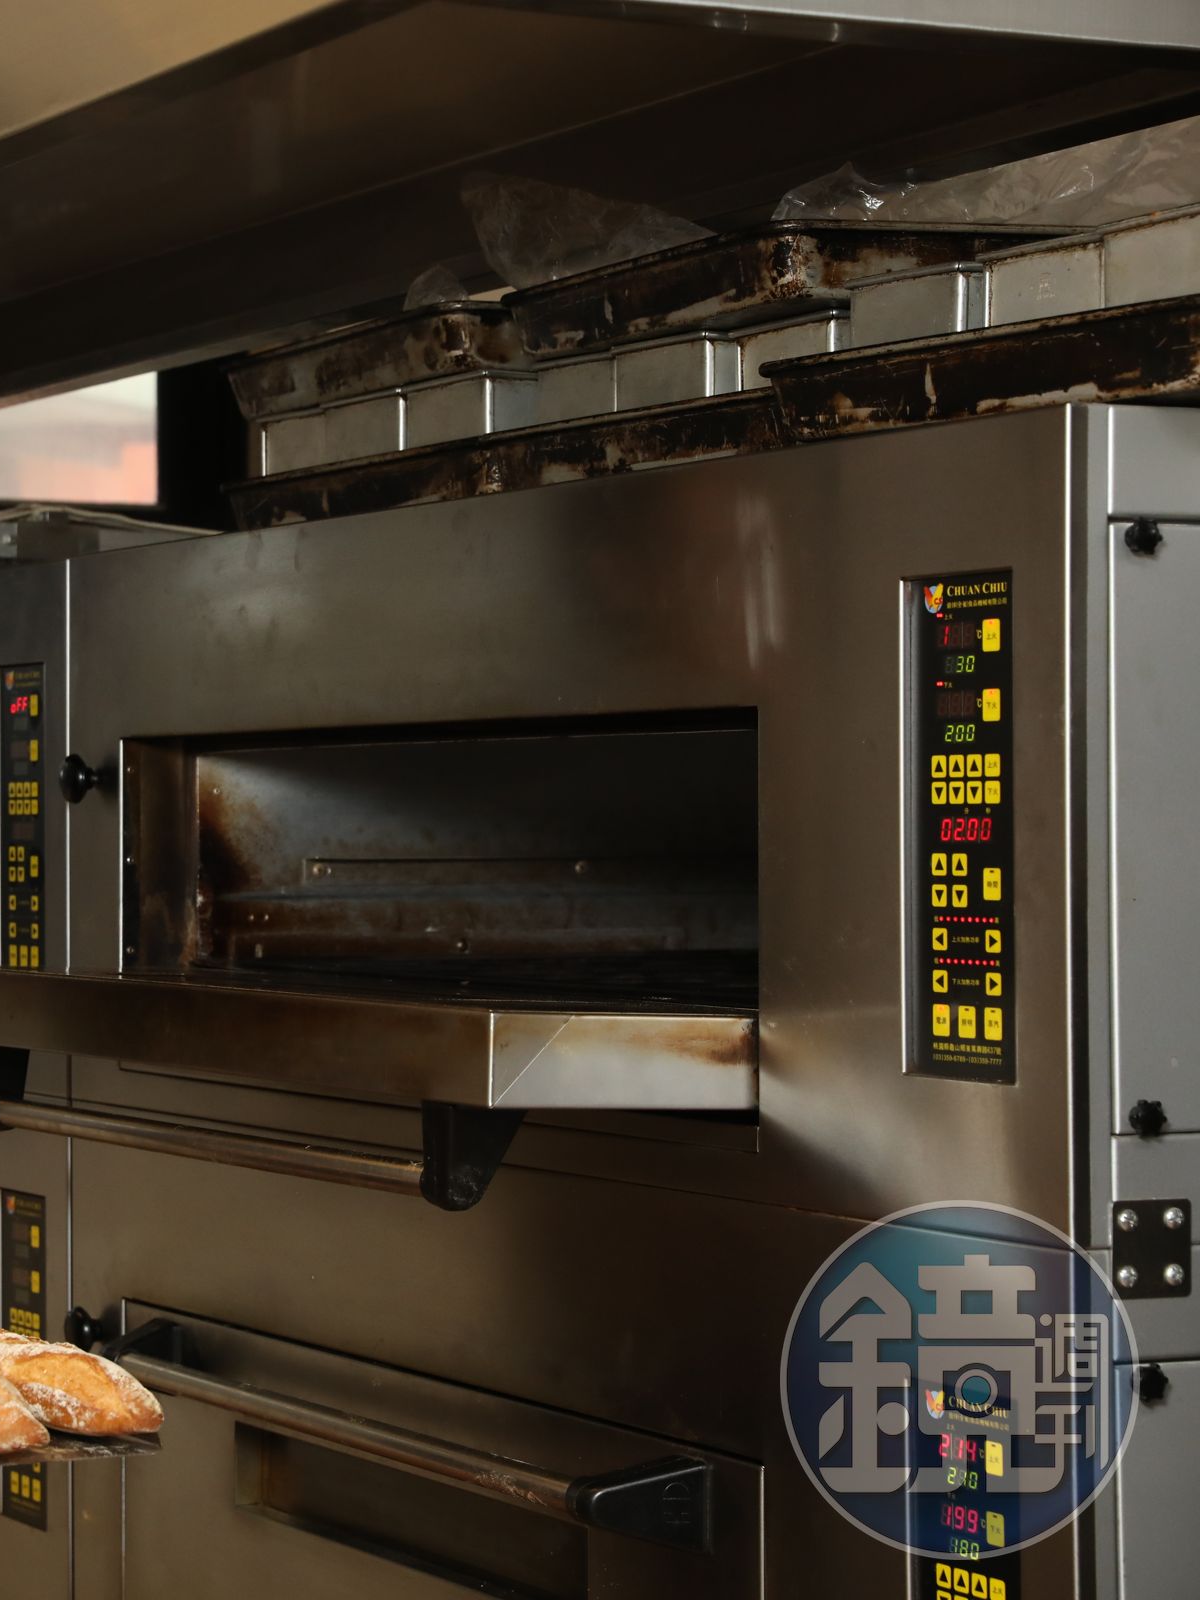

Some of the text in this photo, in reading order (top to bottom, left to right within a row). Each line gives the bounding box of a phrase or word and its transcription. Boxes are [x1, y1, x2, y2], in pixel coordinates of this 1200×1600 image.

[947, 582, 1008, 597] CHUAN CHIU
[956, 655, 976, 673] 30
[945, 724, 976, 742] 200
[941, 817, 992, 841] 02.00
[939, 1433, 977, 1462] 214
[947, 1466, 978, 1490] 210
[945, 1504, 979, 1534] 199
[953, 1538, 980, 1561] 180
